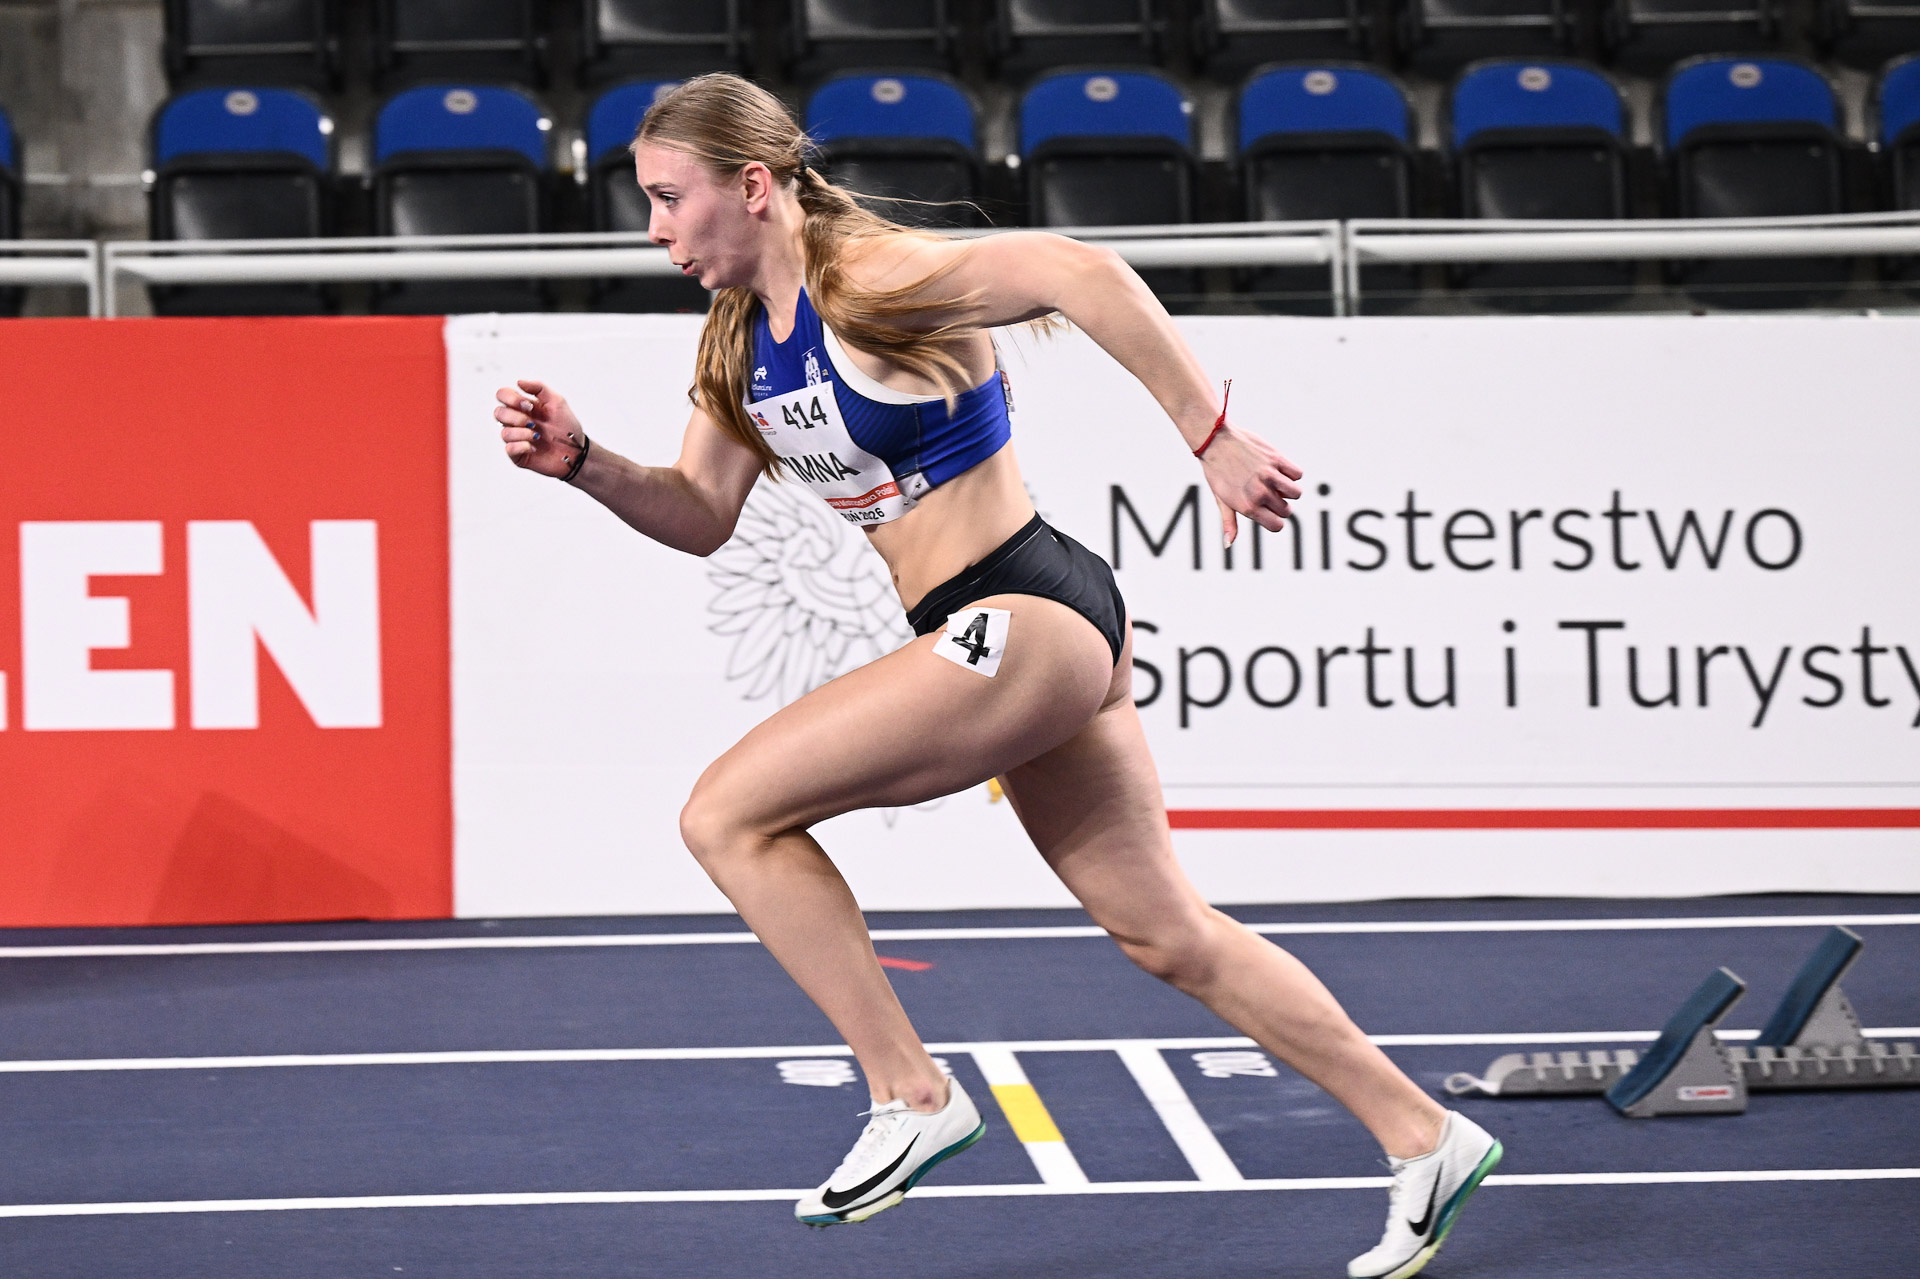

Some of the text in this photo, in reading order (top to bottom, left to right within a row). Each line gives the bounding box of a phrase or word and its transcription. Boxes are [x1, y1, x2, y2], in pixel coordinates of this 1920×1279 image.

[781, 396, 828, 430] 414
[778, 452, 861, 483] IMNA
[0, 520, 382, 730] EN
[952, 612, 990, 666] 4
[1131, 620, 1457, 730] Sportu
[1502, 619, 1517, 708] i
